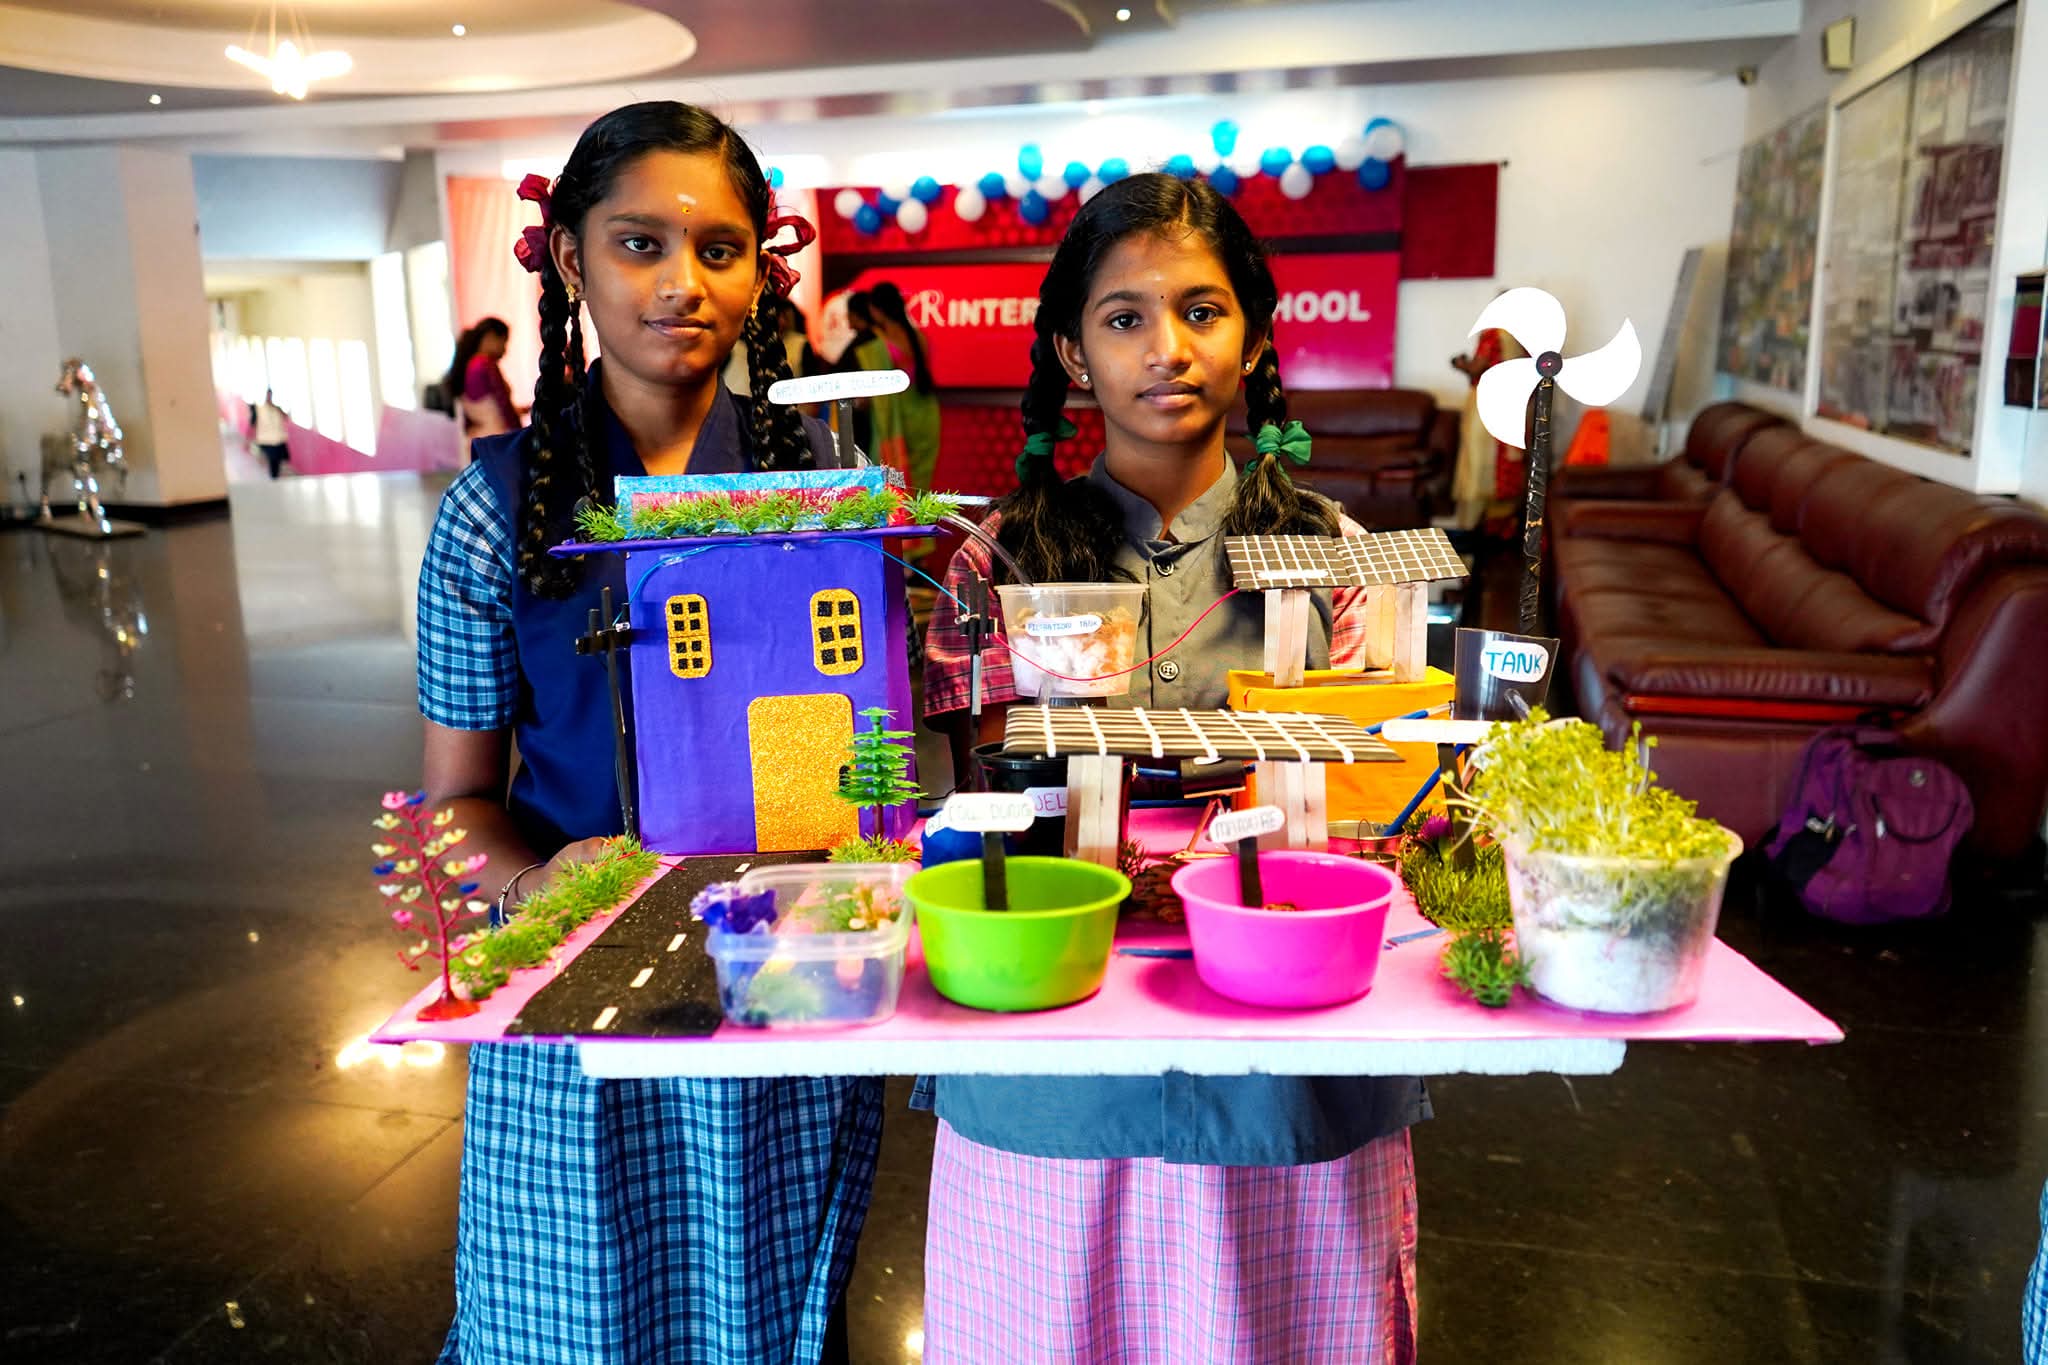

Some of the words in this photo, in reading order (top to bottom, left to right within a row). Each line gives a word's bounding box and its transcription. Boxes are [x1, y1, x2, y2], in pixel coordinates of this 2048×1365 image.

[948, 297, 1040, 327] INTER
[1274, 290, 1372, 323] HOOL
[1485, 650, 1544, 675] TANK
[989, 801, 1032, 820] DUNG
[1034, 793, 1068, 812] UEL
